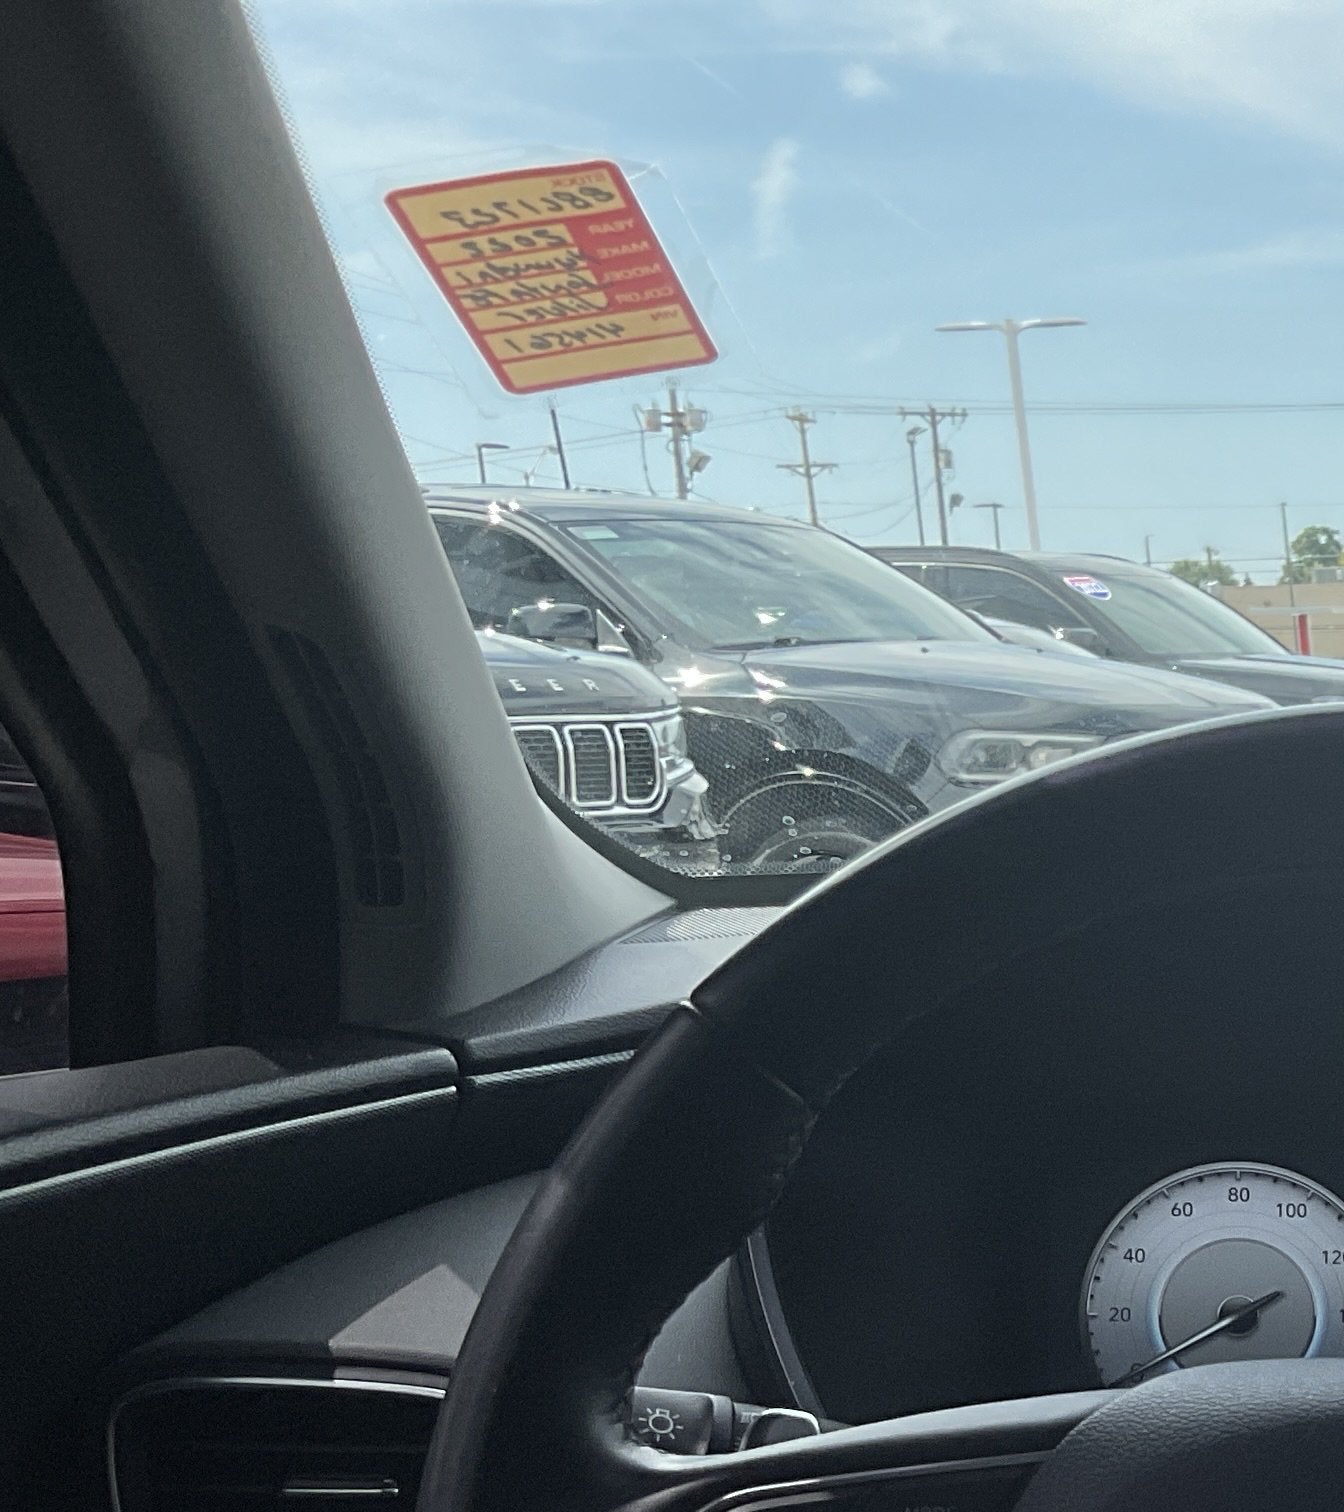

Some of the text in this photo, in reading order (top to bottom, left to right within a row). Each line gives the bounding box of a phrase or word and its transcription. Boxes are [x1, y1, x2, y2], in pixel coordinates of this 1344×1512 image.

[1227, 1187, 1250, 1203] 80
[1170, 1202, 1193, 1217] 60
[1275, 1203, 1308, 1219] 100
[1122, 1248, 1145, 1263] 40
[1108, 1307, 1131, 1322] 20
